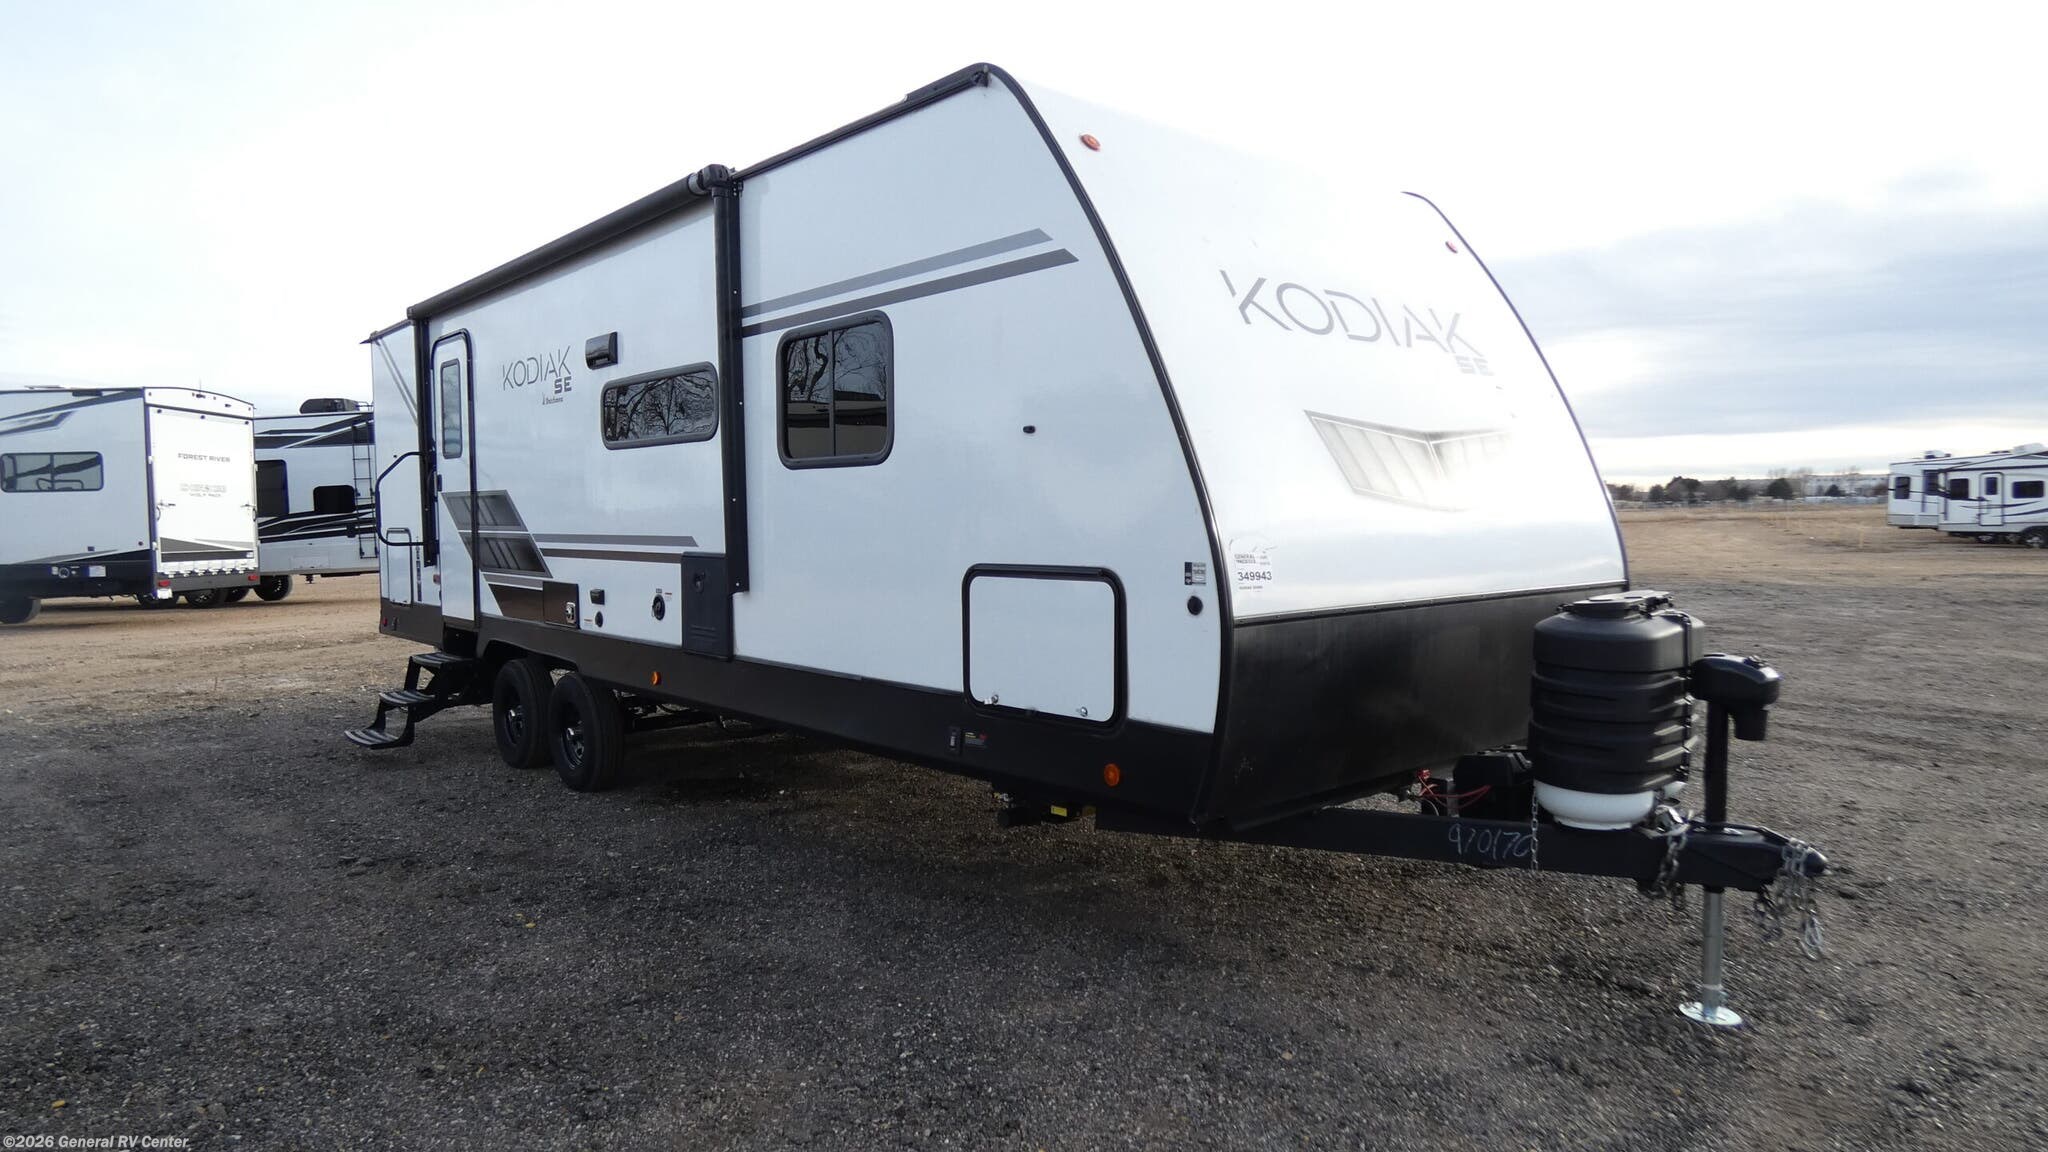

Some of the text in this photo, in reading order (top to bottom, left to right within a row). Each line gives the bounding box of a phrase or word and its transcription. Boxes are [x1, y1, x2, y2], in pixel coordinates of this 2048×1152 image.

[1219, 269, 1484, 357] KODIAK
[502, 345, 571, 391] KODIAK
[1454, 355, 1495, 376] SE
[554, 376, 572, 394] SE
[1237, 571, 1272, 581] 349943
